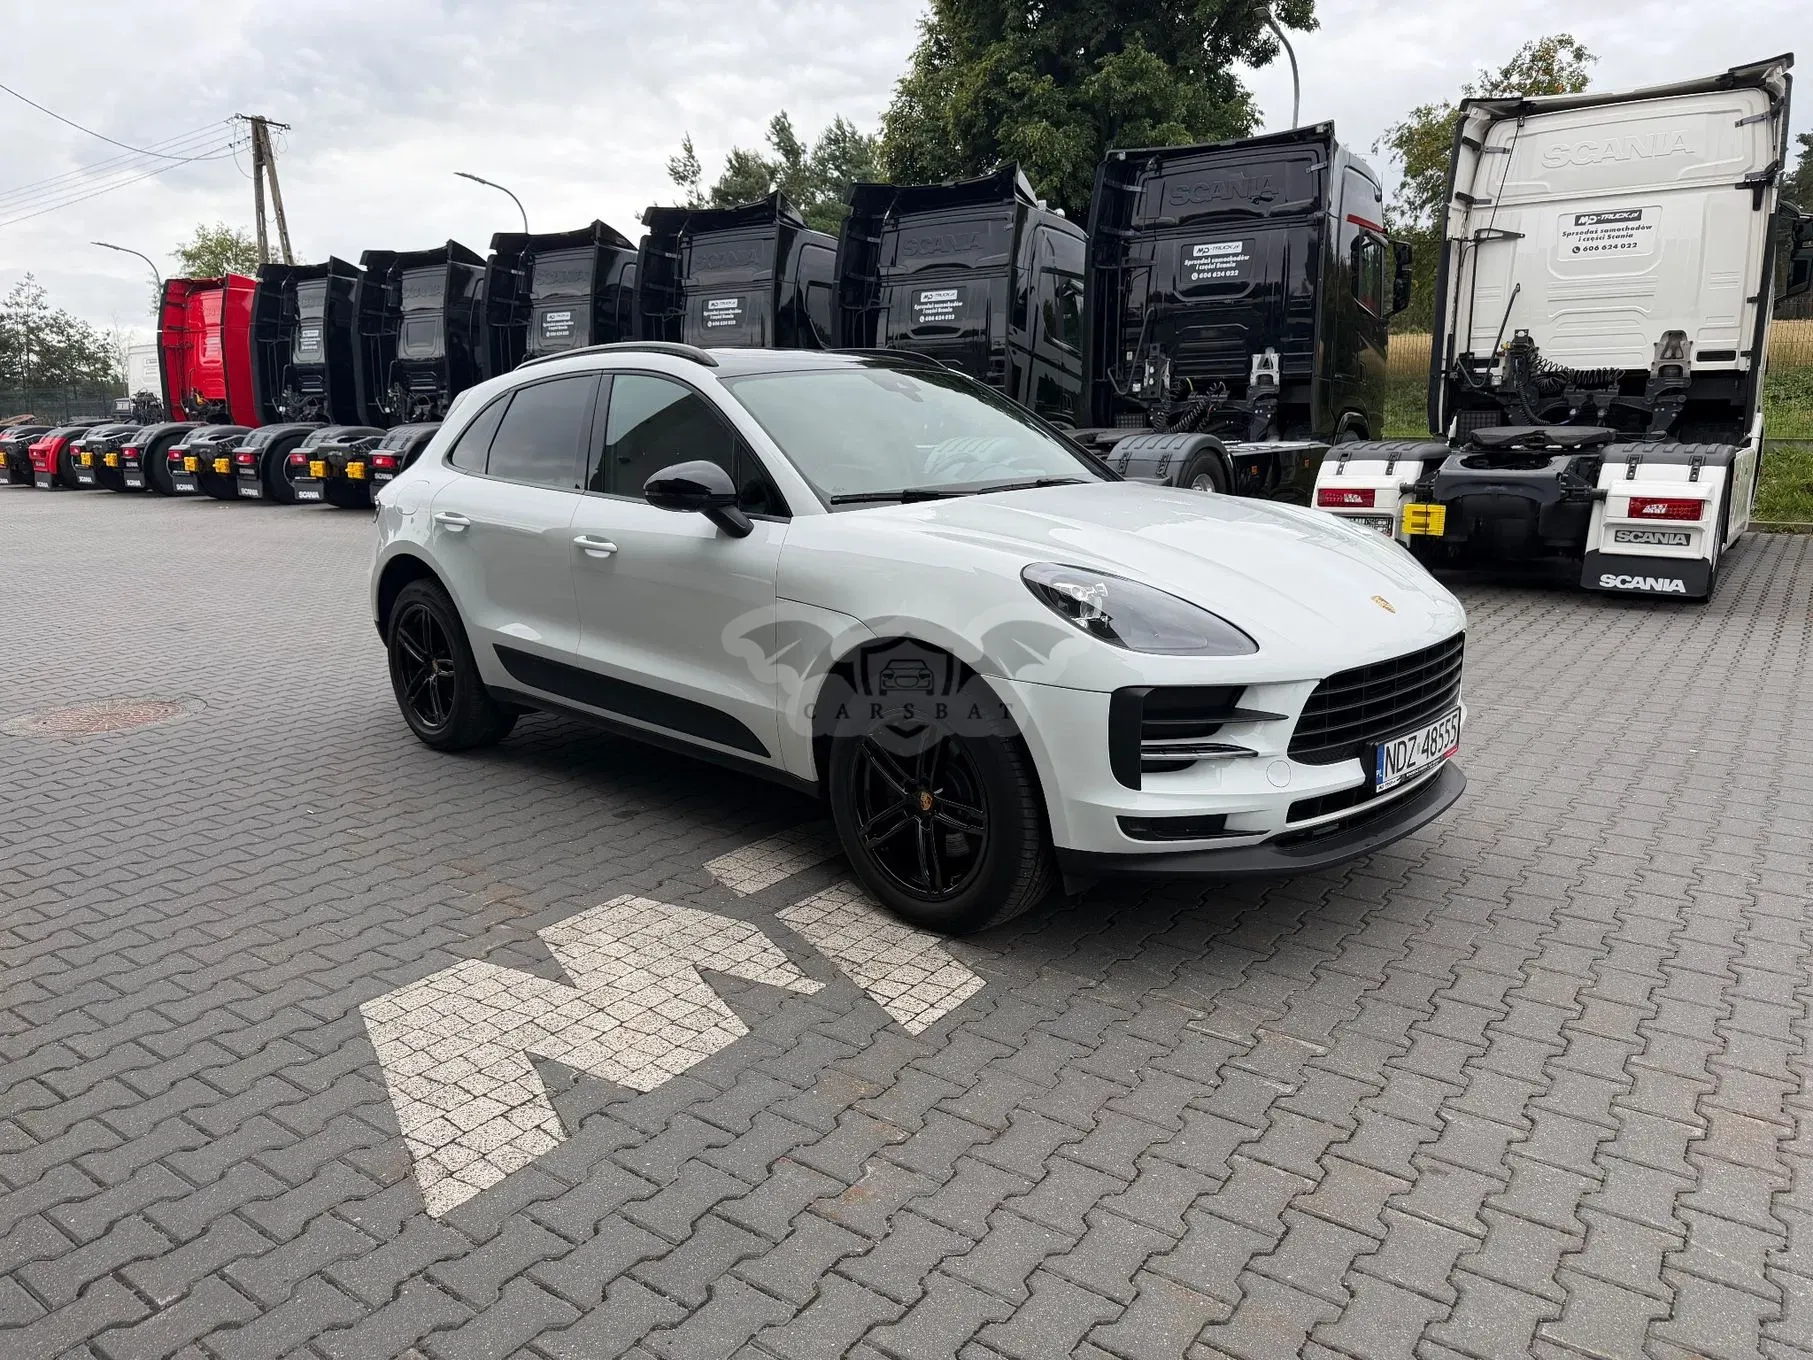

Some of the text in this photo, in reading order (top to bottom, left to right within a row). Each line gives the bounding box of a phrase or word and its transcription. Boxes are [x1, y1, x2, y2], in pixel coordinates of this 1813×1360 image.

[1542, 130, 1695, 169] SCANIA
[1169, 175, 1280, 206] SCANIA
[1562, 224, 1653, 238] Sprzedaż samochodów
[176, 483, 194, 492] SCANIA
[298, 490, 320, 499] SCANIA
[1616, 530, 1688, 545] SCANIA
[1599, 574, 1686, 593] SCANIA
[1385, 713, 1458, 778] NDZ 48555
